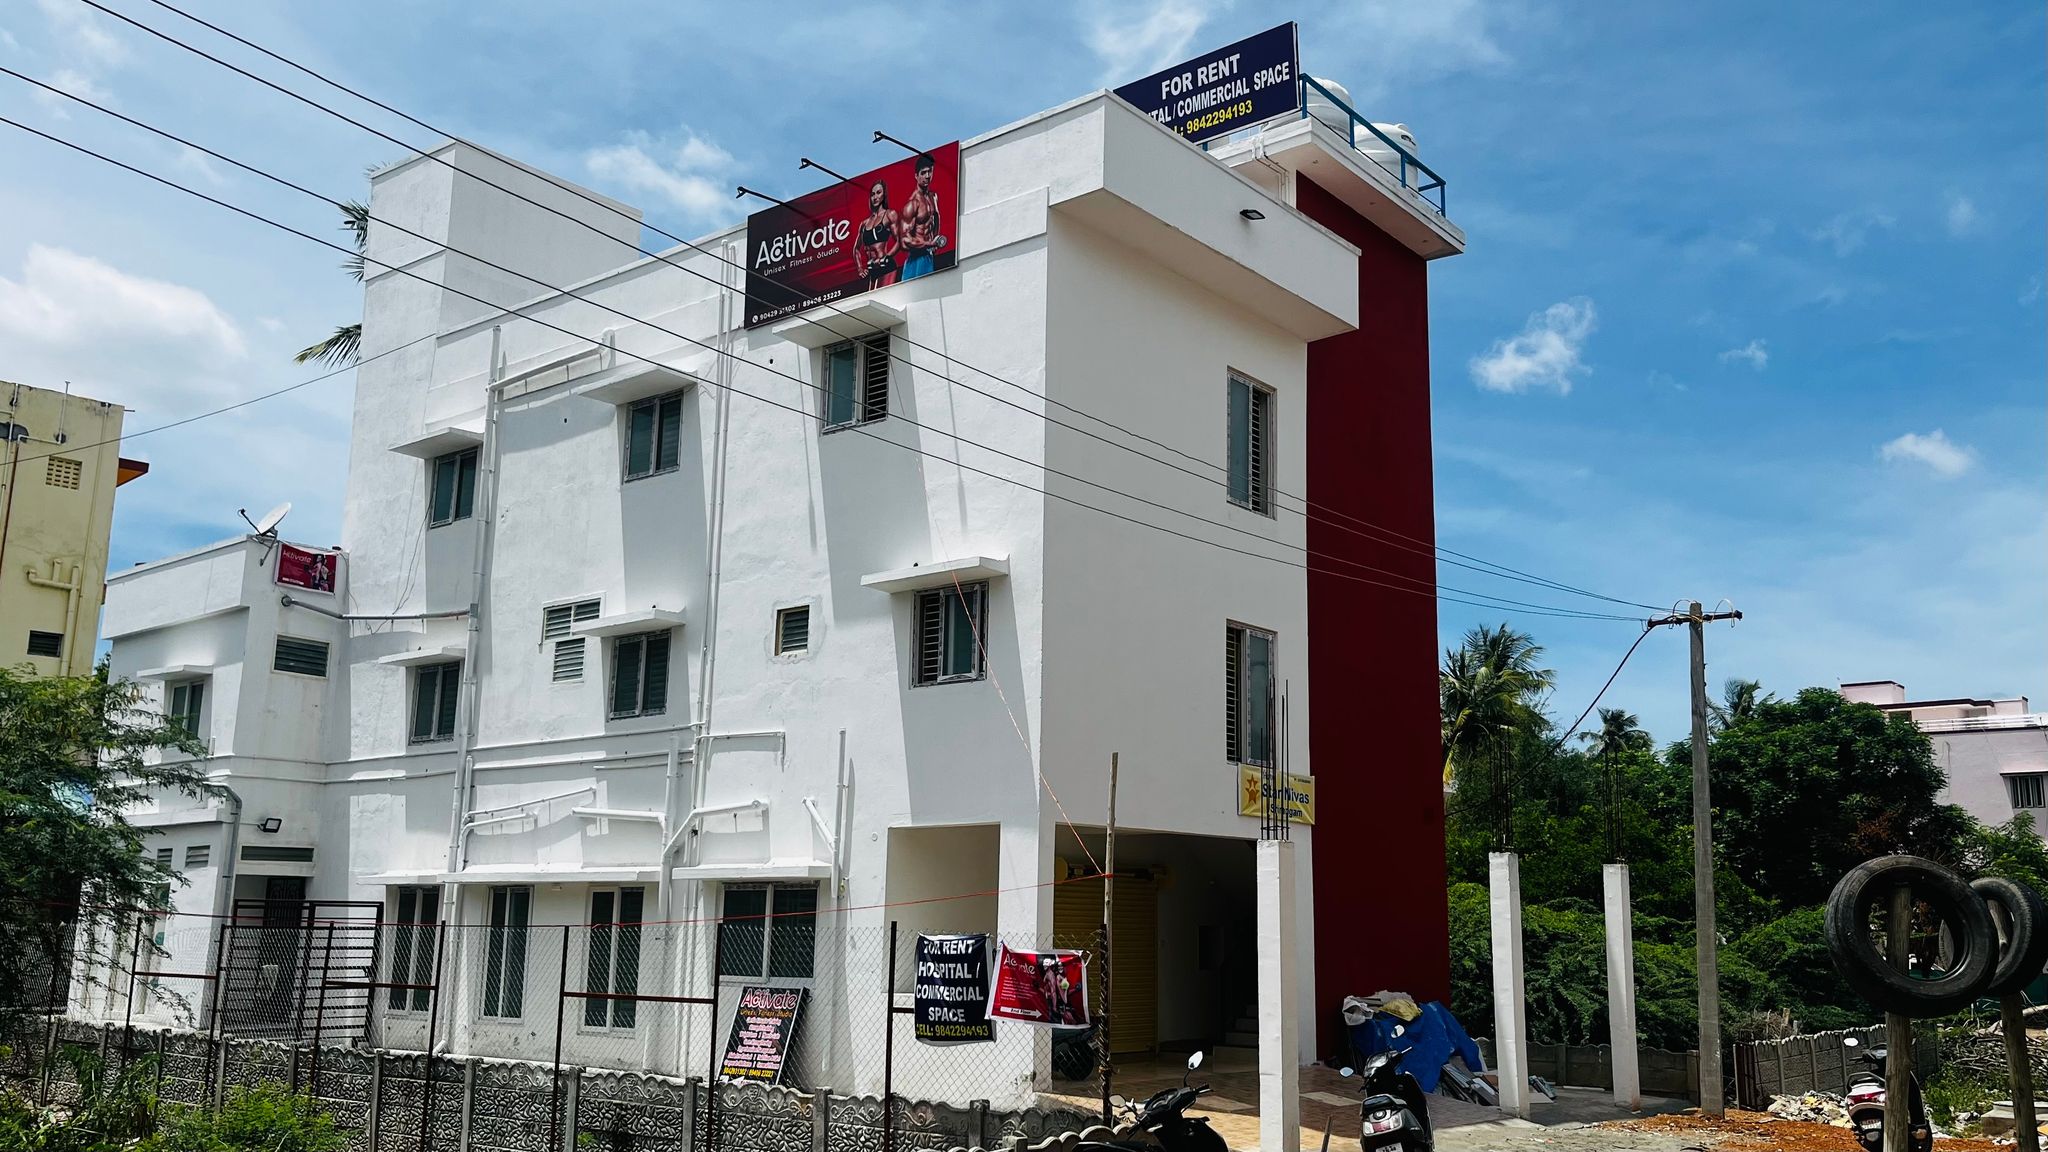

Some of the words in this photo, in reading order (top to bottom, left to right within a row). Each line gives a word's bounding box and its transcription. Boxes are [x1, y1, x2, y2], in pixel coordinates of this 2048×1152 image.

[1161, 72, 1193, 100] FOR
[1197, 53, 1241, 87] RENT
[1148, 105, 1172, 124] TAL
[1177, 77, 1250, 118] COMMERCIAL
[1253, 61, 1290, 91] SPACE
[1186, 100, 1253, 134] 9842294193
[755, 218, 850, 269] Activate
[763, 265, 786, 276] Unisex
[789, 256, 813, 268] Fitness
[816, 247, 840, 259] Studio
[943, 940, 976, 955] RENT
[918, 961, 972, 979] HOSPITAL
[740, 988, 798, 1010] Activate
[928, 1006, 966, 1023] SPACE
